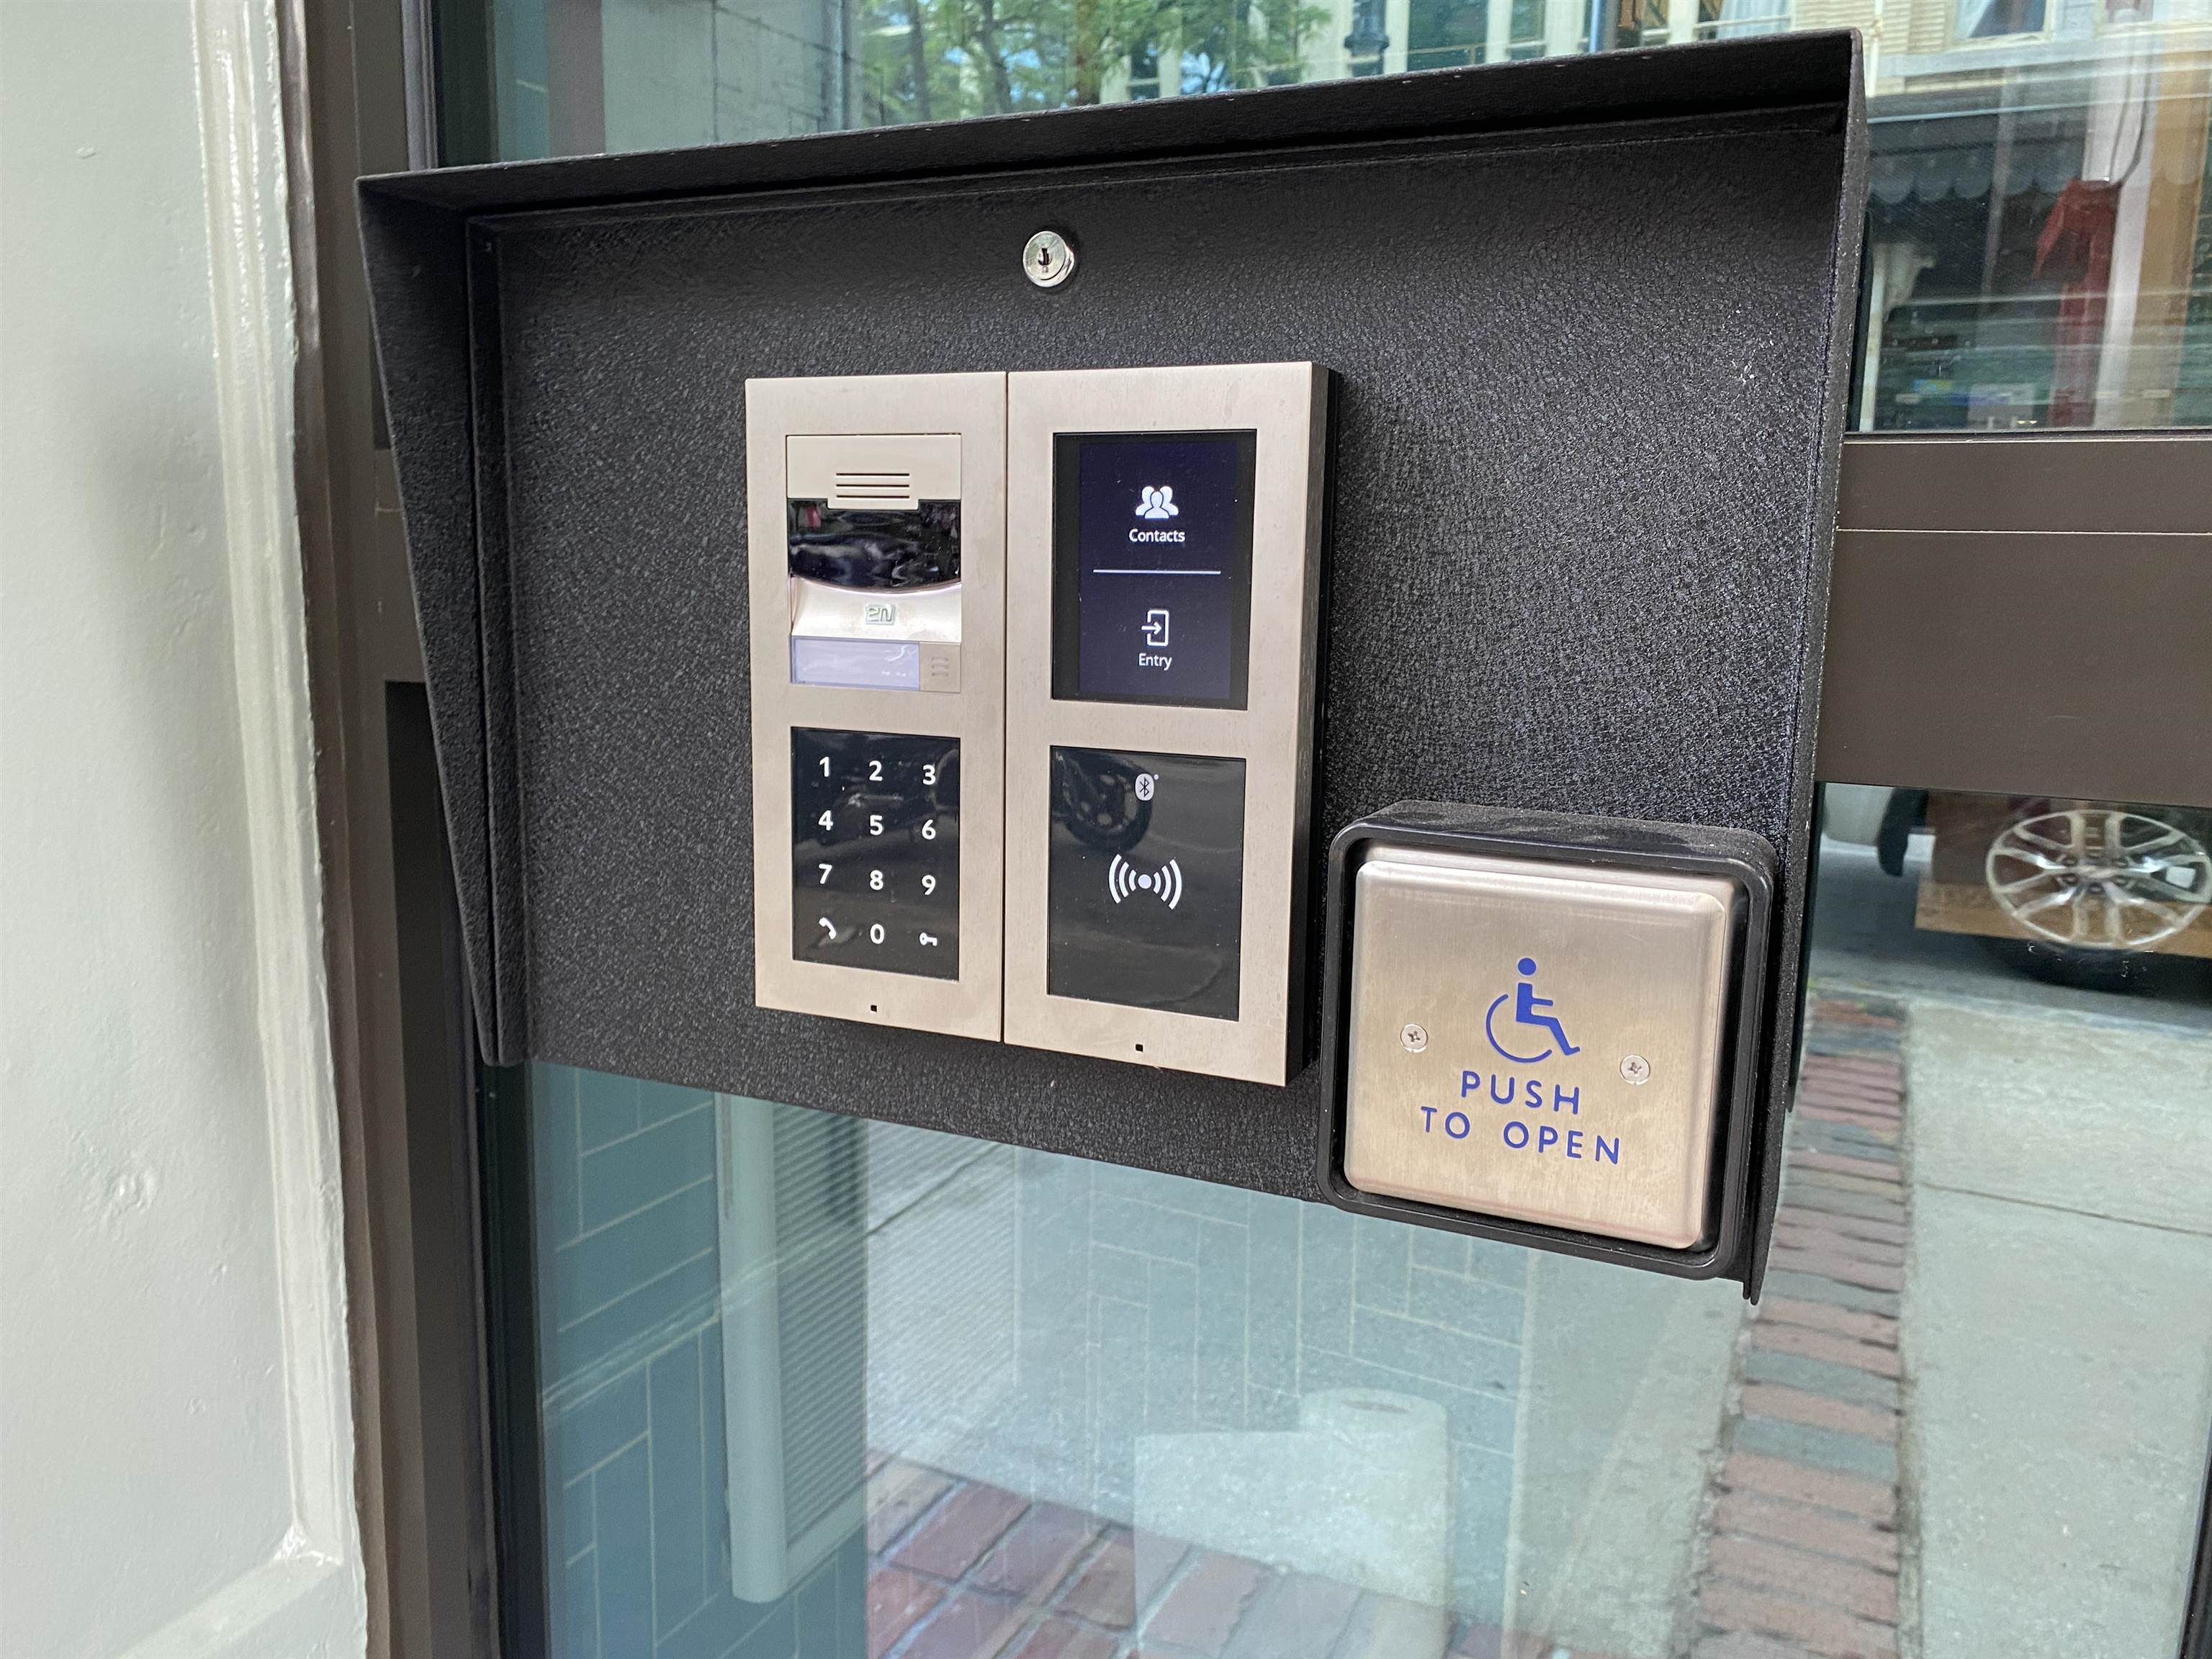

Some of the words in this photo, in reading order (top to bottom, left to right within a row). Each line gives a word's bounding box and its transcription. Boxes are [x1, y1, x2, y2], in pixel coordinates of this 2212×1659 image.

[1128, 528, 1186, 543] Contacts
[1138, 652, 1173, 671] Entry
[819, 756, 830, 778] 1
[869, 760, 883, 781] 2
[922, 764, 936, 786] 3
[818, 809, 834, 831] 4
[870, 814, 884, 836] 5
[921, 819, 936, 840] 6
[818, 863, 833, 884] 7
[869, 869, 884, 891] 8
[921, 874, 936, 896] 9
[870, 923, 885, 945] 0
[1460, 1070, 1580, 1115] PUSH
[1421, 1105, 1471, 1140] TO
[1503, 1120, 1620, 1165] OPEN
